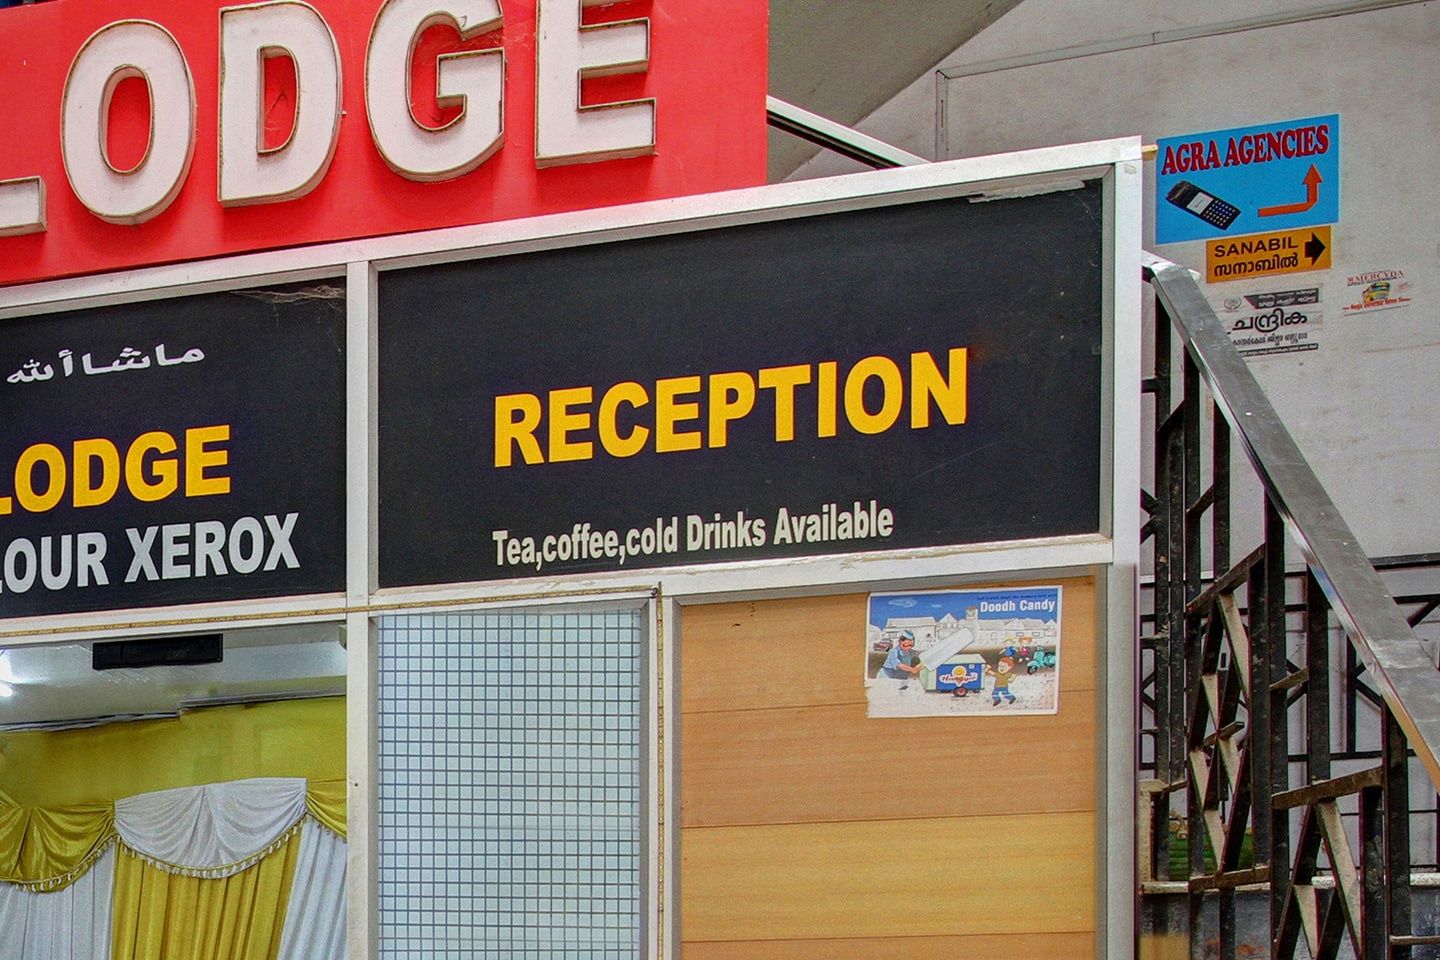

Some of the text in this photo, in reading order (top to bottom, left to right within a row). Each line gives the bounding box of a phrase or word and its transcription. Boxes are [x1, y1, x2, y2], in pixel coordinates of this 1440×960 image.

[1161, 124, 1329, 175] AGRA AGENCIES
[1214, 236, 1298, 258] SANABIL
[1214, 252, 1298, 276] സനാബിൽ
[1232, 308, 1307, 333] ചന്ദ്രിക
[494, 347, 968, 467] RECEPTION
[125, 512, 300, 583] XEROX
[492, 500, 894, 571] Tea,coffee,cold Drinks Available
[980, 599, 1055, 612] Doodh Candy
